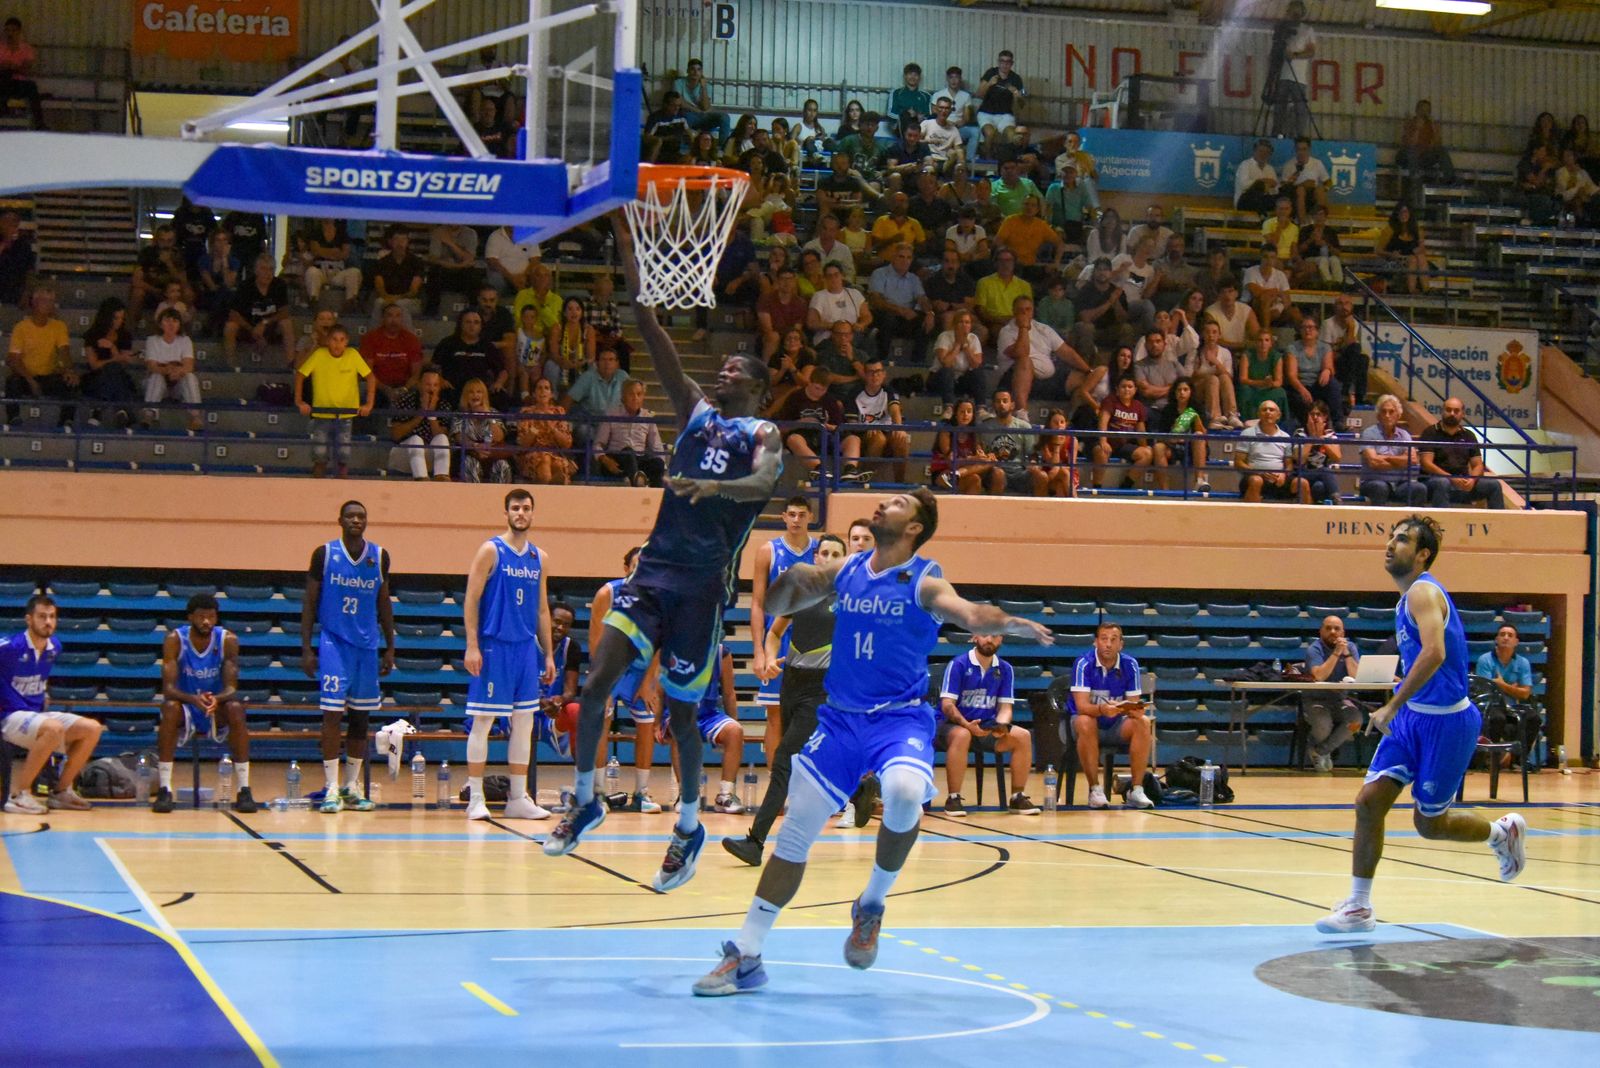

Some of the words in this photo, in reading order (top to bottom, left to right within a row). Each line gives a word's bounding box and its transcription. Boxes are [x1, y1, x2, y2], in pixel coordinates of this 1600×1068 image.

[142, 3, 290, 37] Cafetería
[716, 4, 735, 38] B
[1178, 52, 1384, 105] FUAR
[1092, 154, 1150, 166] yuntamiento
[1100, 164, 1151, 178] Algeciras
[1114, 408, 1139, 422] ROMA
[1474, 403, 1529, 420] Agiras
[700, 447, 730, 474] 35
[1326, 521, 1395, 536] PRENS
[330, 572, 375, 590] Huelva
[502, 564, 540, 580] Huelva
[342, 597, 358, 615] 23
[516, 588, 524, 606] 9
[839, 592, 904, 616] Huelva
[853, 631, 874, 660] 14
[323, 674, 340, 693] 23
[487, 681, 494, 698] 9
